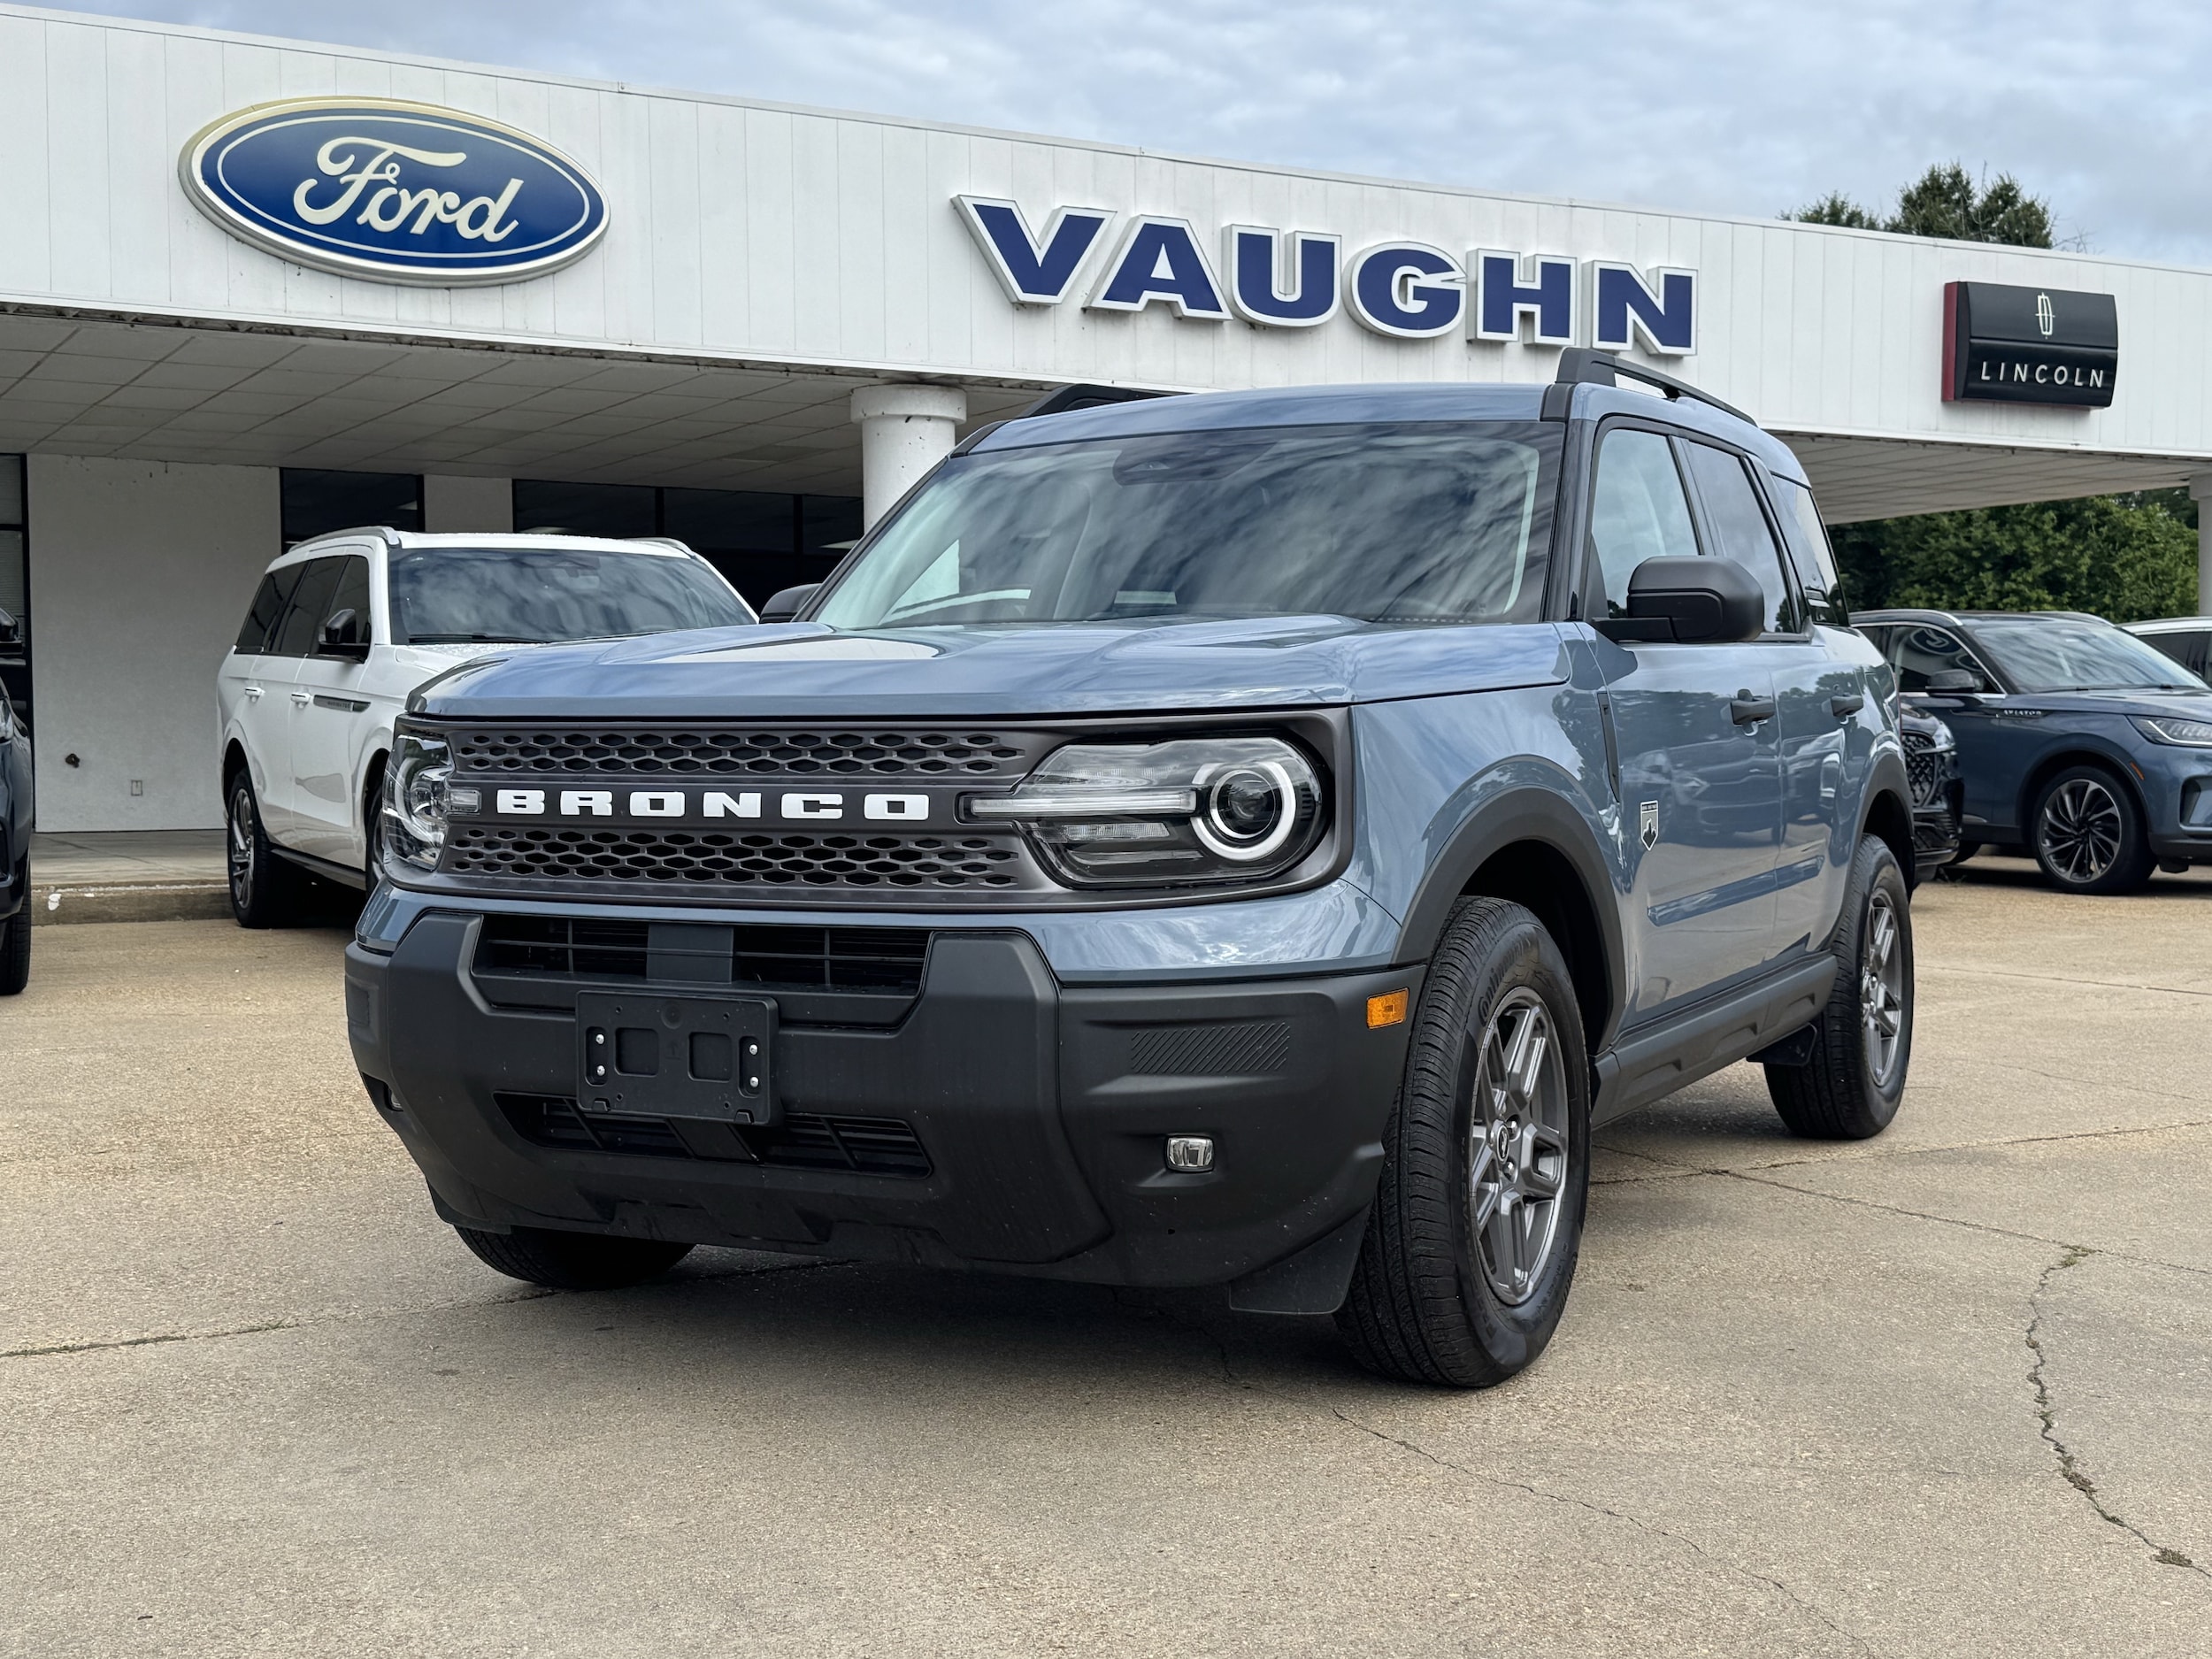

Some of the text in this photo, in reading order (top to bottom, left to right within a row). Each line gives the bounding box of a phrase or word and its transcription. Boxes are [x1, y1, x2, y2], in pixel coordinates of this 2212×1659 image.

[293, 136, 524, 242] Ford
[953, 195, 1696, 356] VAUGHN
[1980, 361, 2104, 388] LINCOLN
[496, 788, 930, 821] BRONCO
